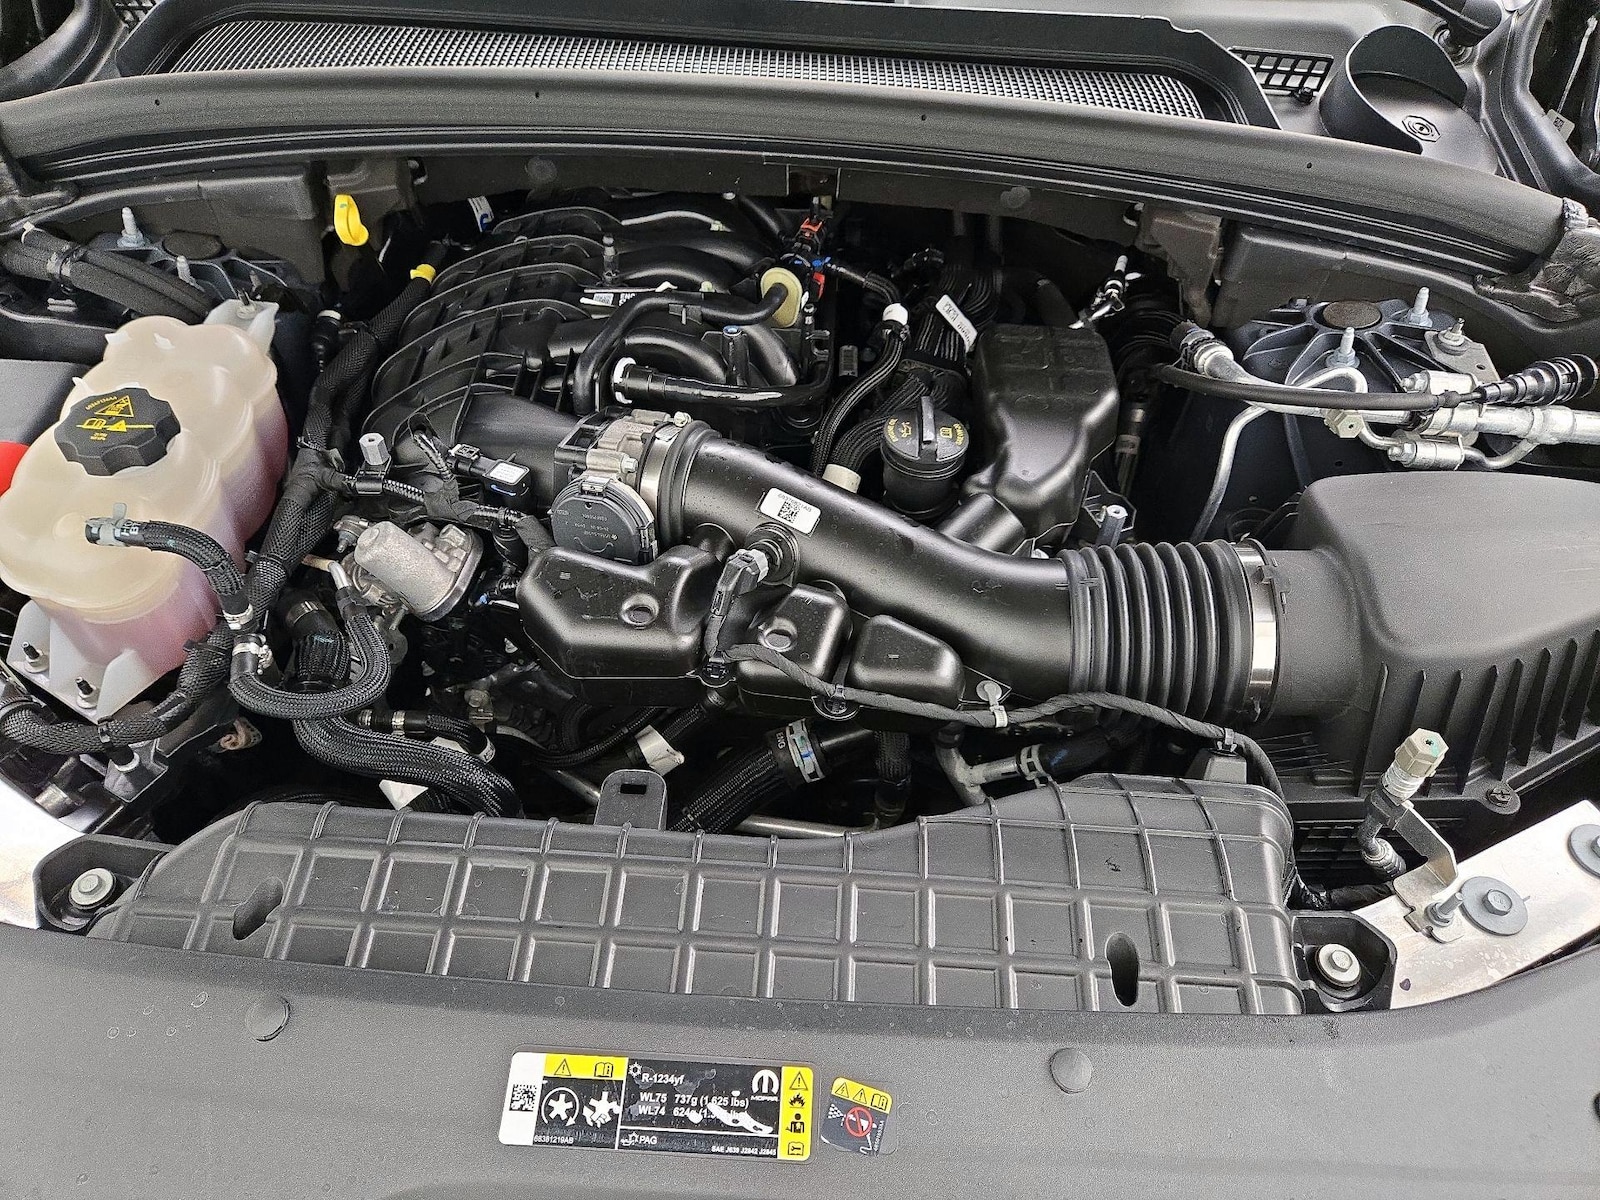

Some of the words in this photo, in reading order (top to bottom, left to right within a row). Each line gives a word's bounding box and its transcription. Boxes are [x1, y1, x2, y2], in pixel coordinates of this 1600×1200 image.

[776, 732, 786, 749] ENG
[641, 1073, 685, 1086] R-1234yf
[640, 1092, 667, 1103] WL75
[674, 1094, 698, 1107] 737g
[700, 1095, 729, 1107] (1625
[730, 1097, 749, 1109] lbs)
[638, 1105, 666, 1115] WL74
[638, 1136, 658, 1145] PAG
[711, 1145, 725, 1153] SAE
[725, 1146, 740, 1154] J639
